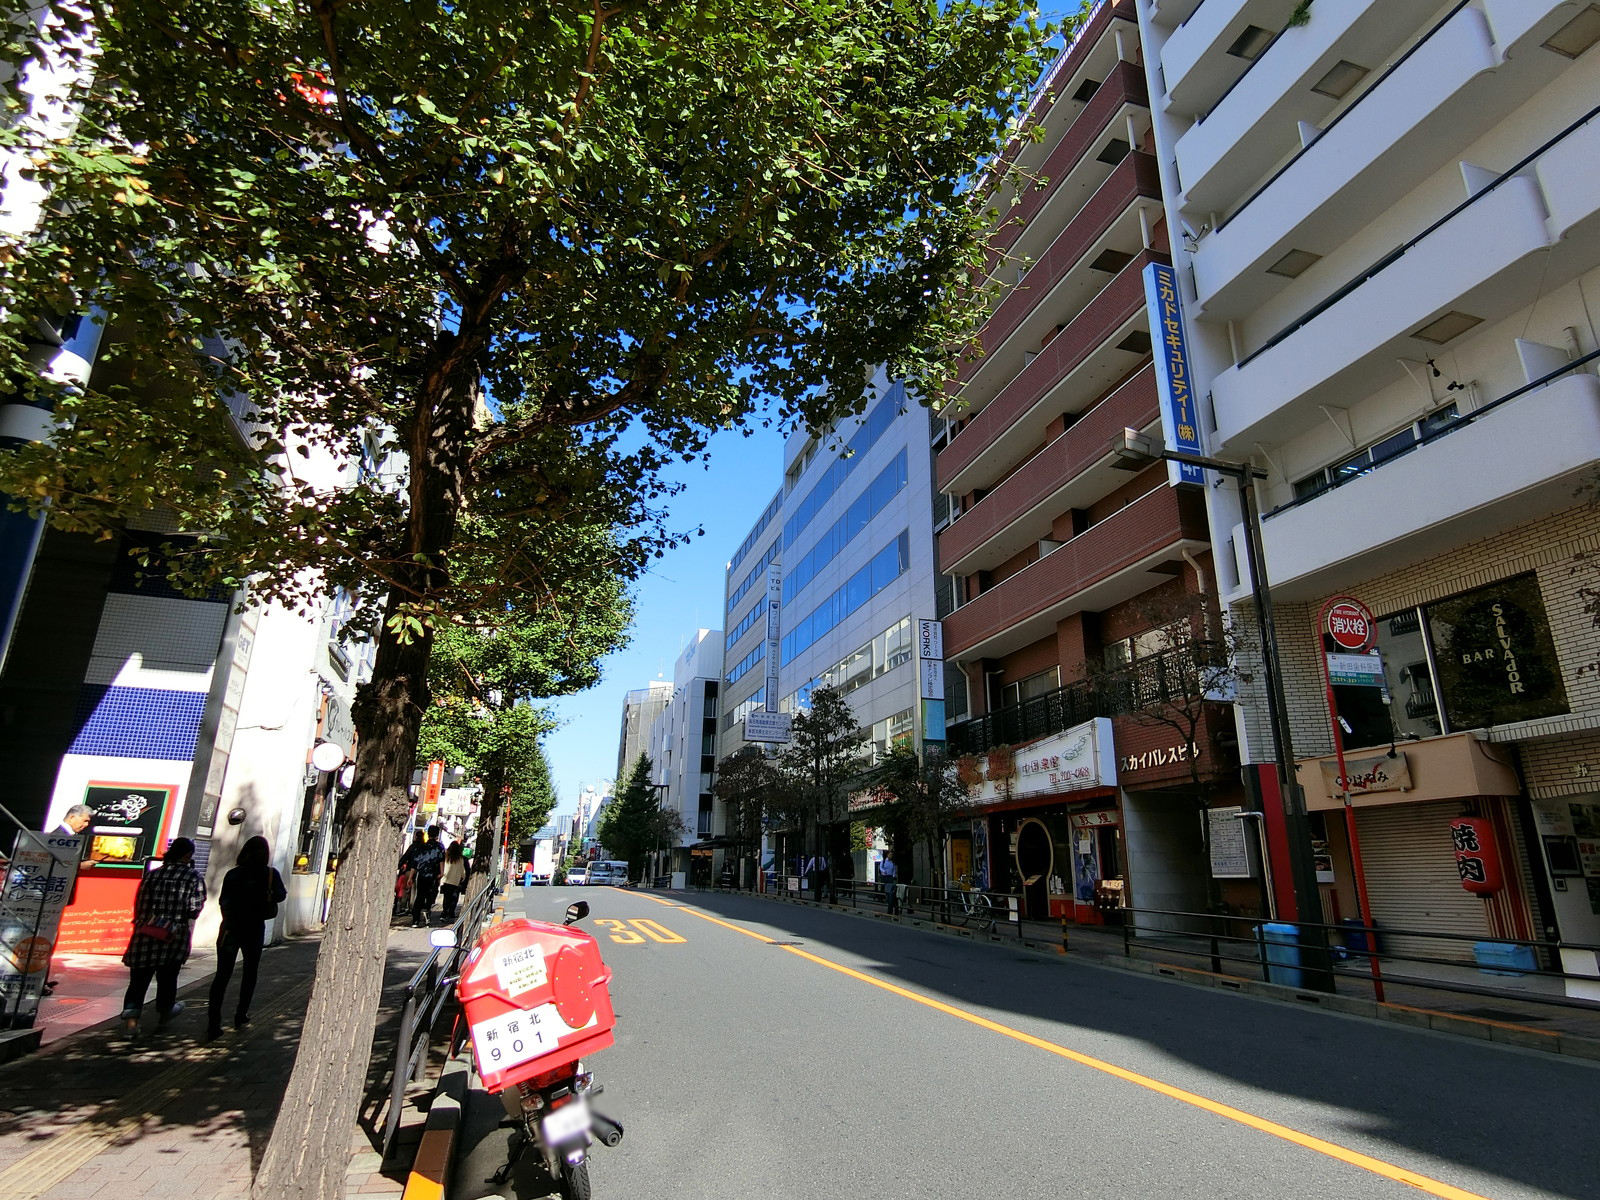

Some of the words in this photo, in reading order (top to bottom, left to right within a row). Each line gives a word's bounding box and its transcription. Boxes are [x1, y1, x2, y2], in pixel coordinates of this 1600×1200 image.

[1331, 616, 1366, 636] 消火栓
[921, 622, 931, 657] WORKS
[1462, 648, 1495, 666] BAR
[57, 838, 80, 848] GET
[1449, 822, 1486, 884] 焼肉
[10, 874, 67, 893] 英会話
[593, 917, 688, 945] 30
[502, 948, 535, 967] 新宿北
[486, 1013, 541, 1042] 新宿北
[491, 1031, 543, 1061] 901
